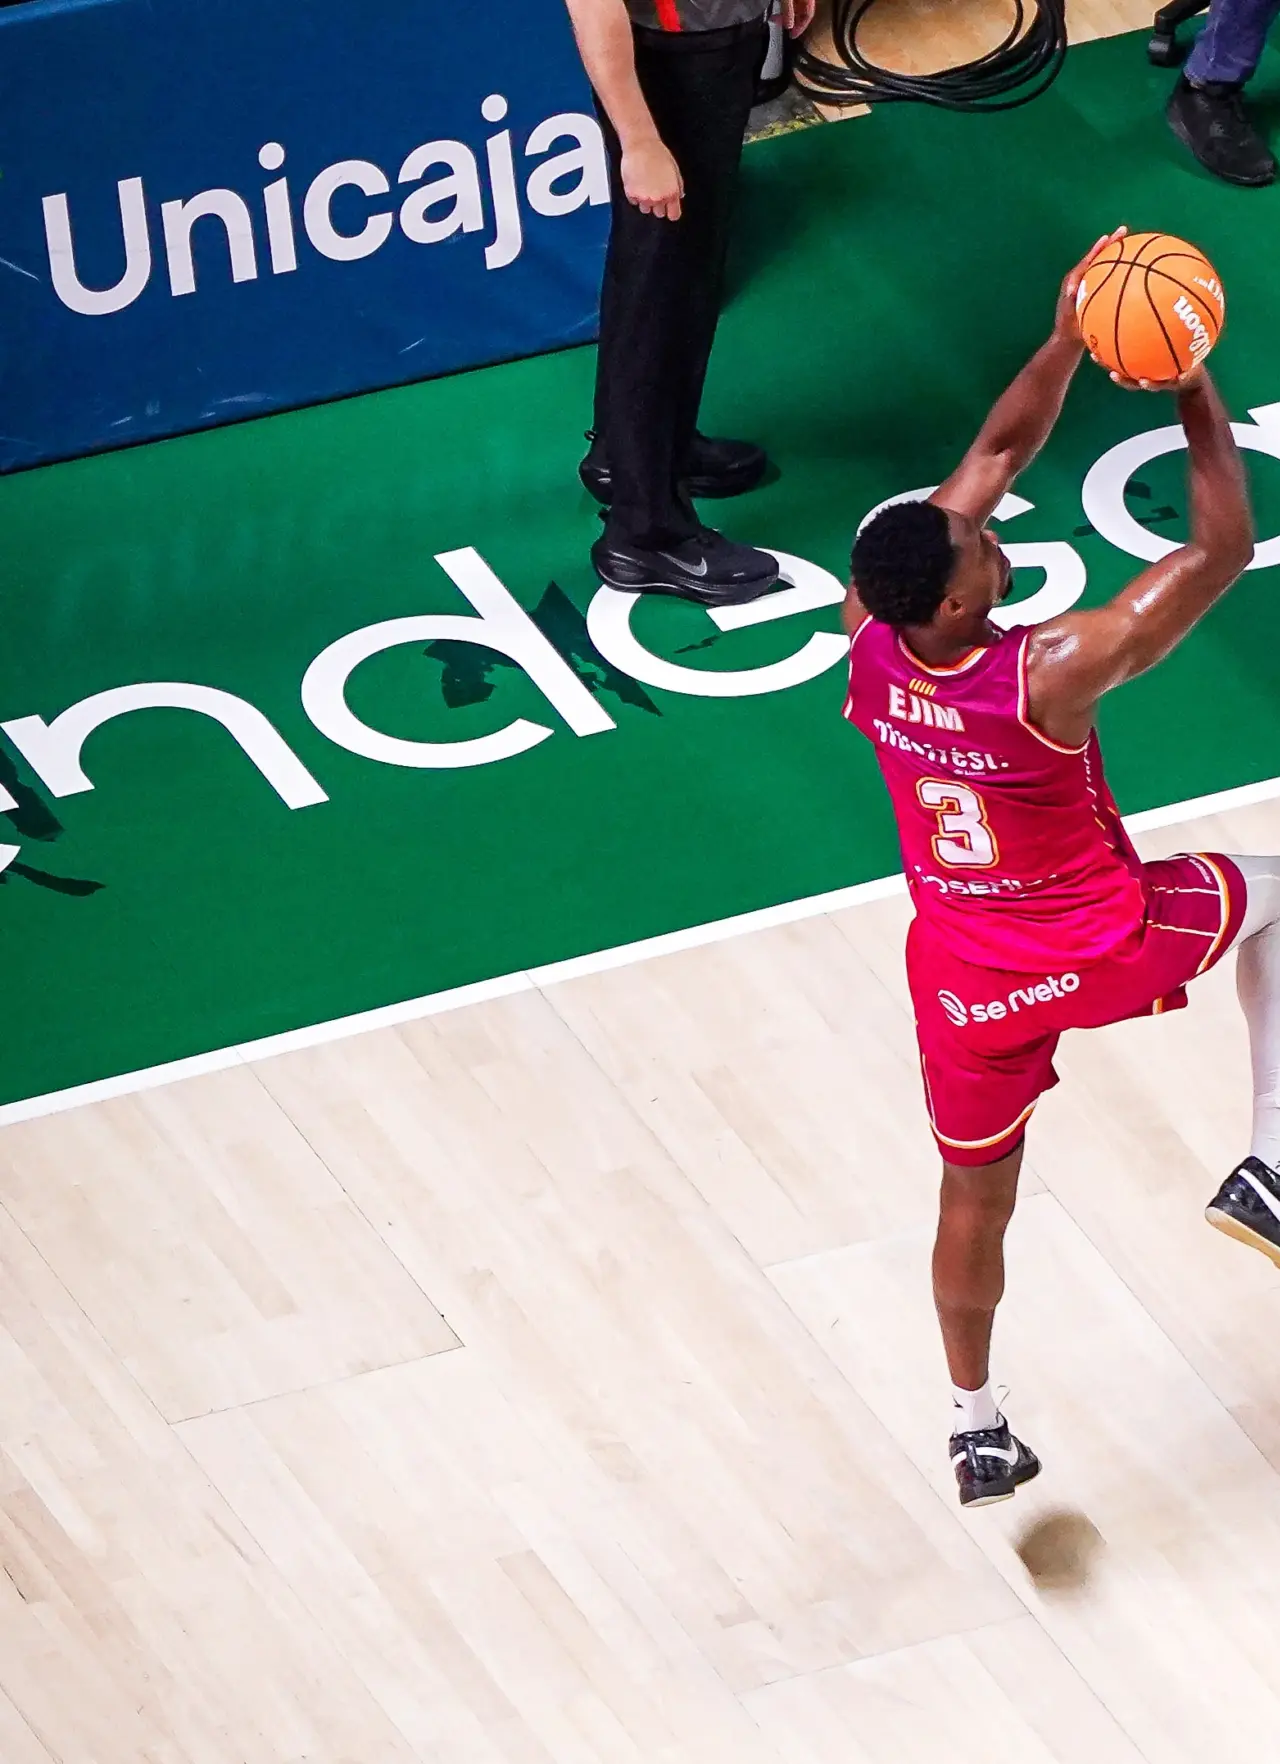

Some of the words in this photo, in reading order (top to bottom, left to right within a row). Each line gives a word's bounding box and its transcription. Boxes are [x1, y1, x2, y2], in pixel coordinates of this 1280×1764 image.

[42, 94, 610, 316] Unicaja
[887, 683, 966, 732] EJIM
[915, 776, 1000, 869] 3
[969, 972, 1081, 1023] serveto
